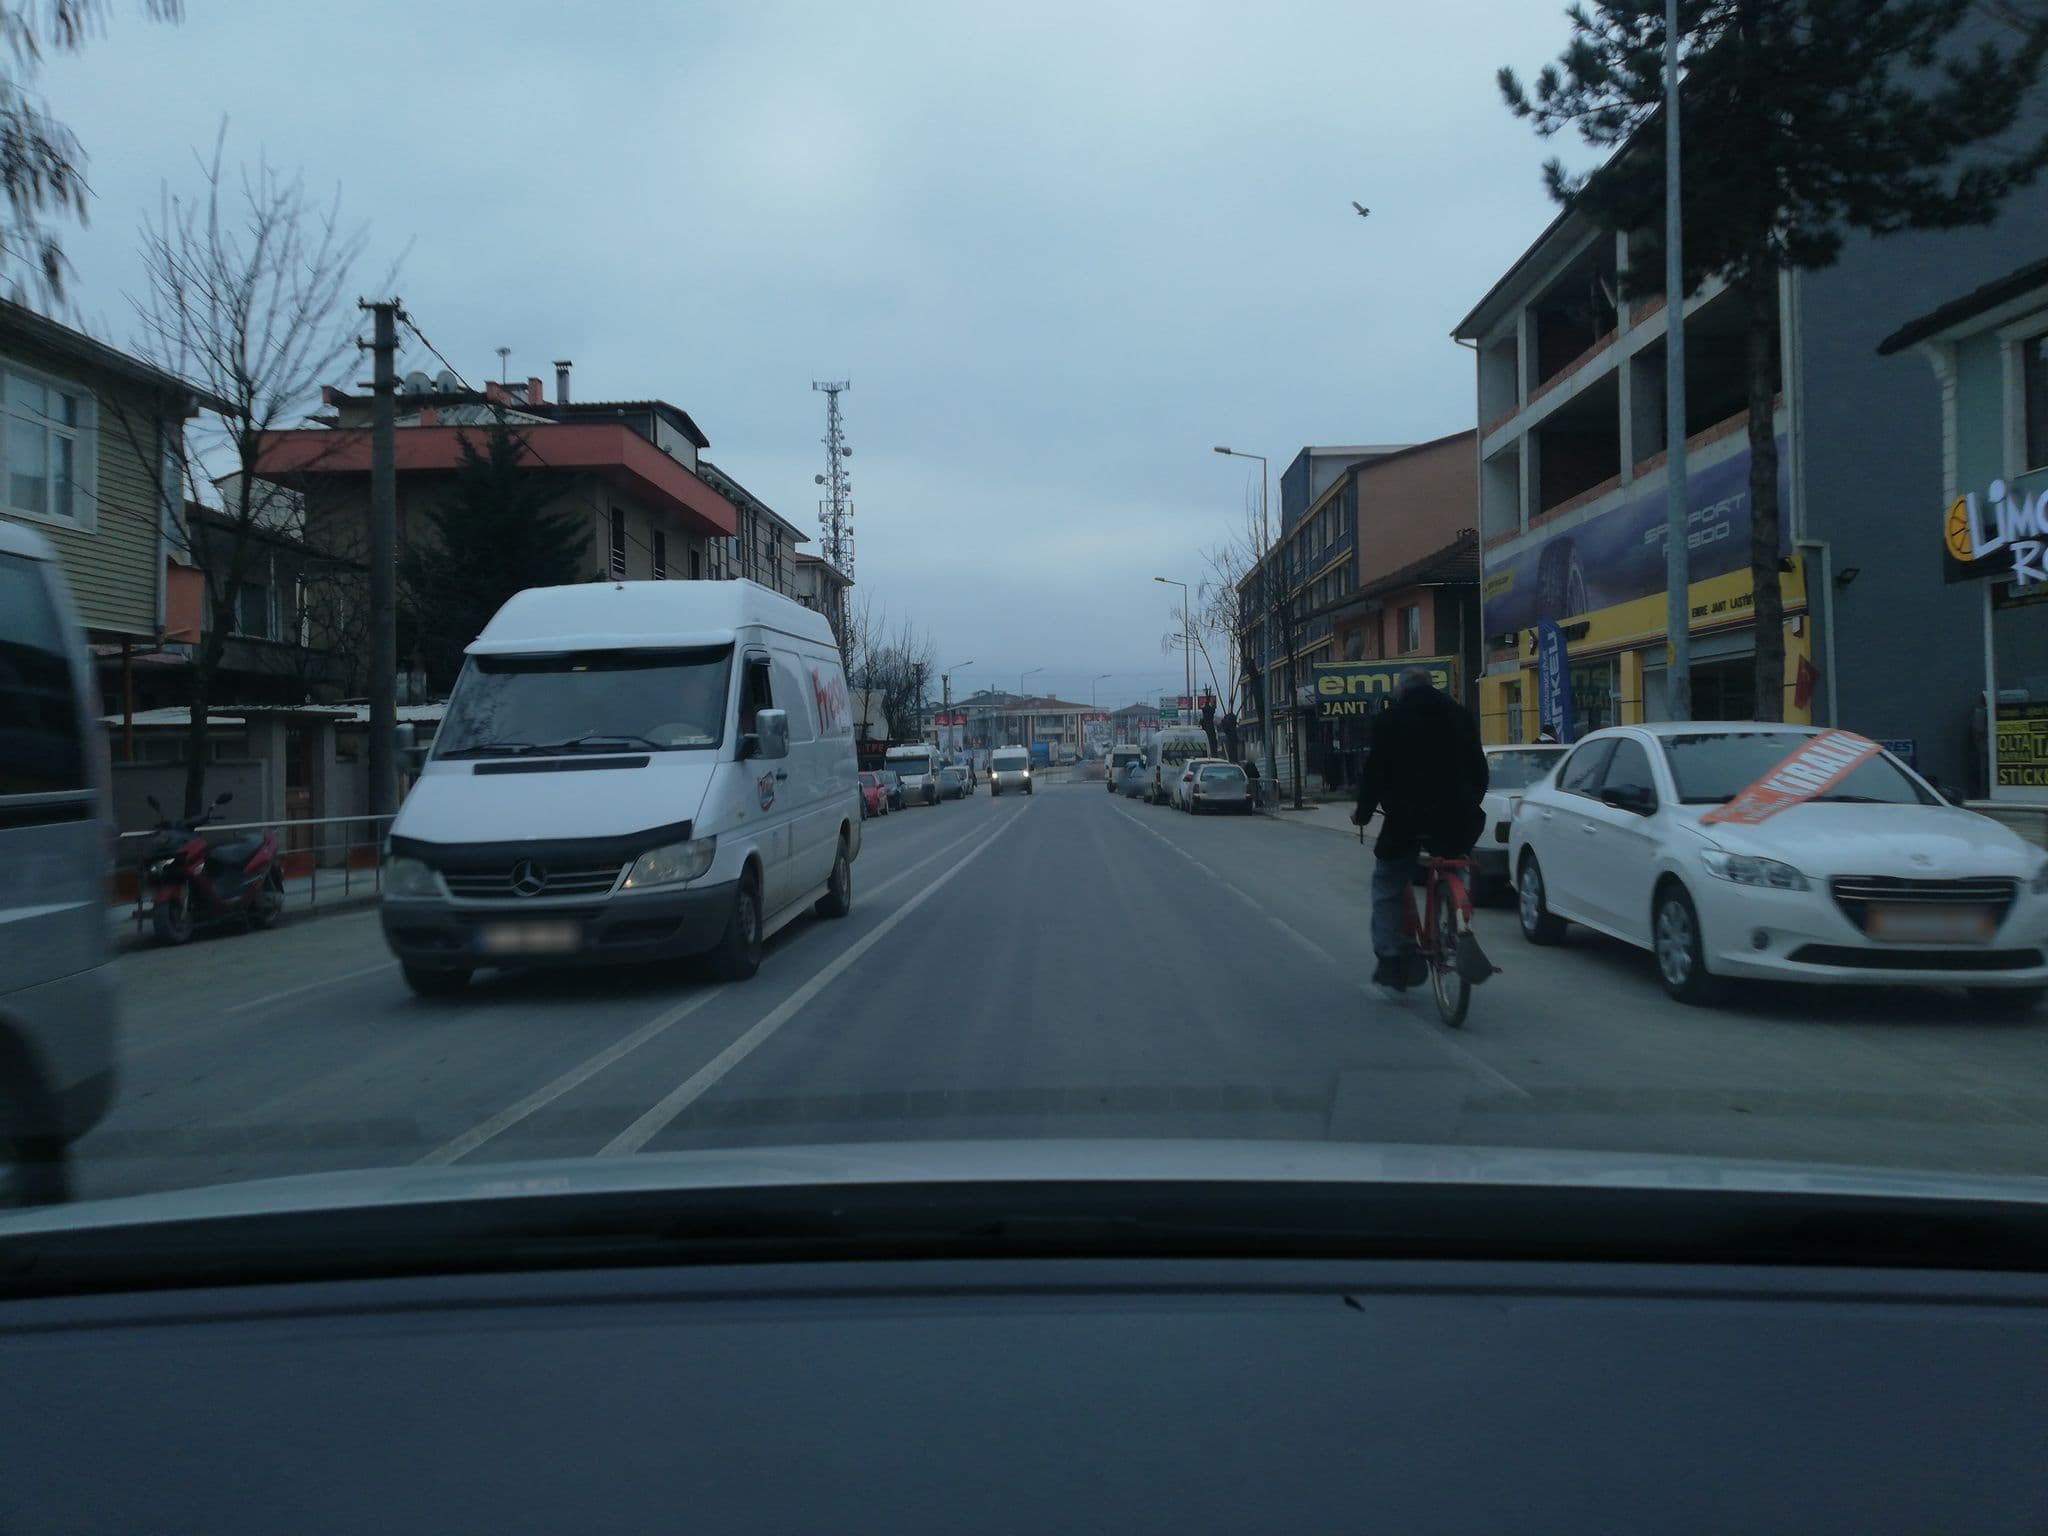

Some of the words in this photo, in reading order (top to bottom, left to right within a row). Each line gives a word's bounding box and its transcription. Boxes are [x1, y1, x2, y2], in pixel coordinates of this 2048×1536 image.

[1683, 490, 1746, 528] PORT
[1547, 630, 1564, 742] ALKEN
[1321, 699, 1369, 716] JANT
[1999, 734, 2031, 752] OLTA
[1759, 732, 1877, 797] KIRALIK
